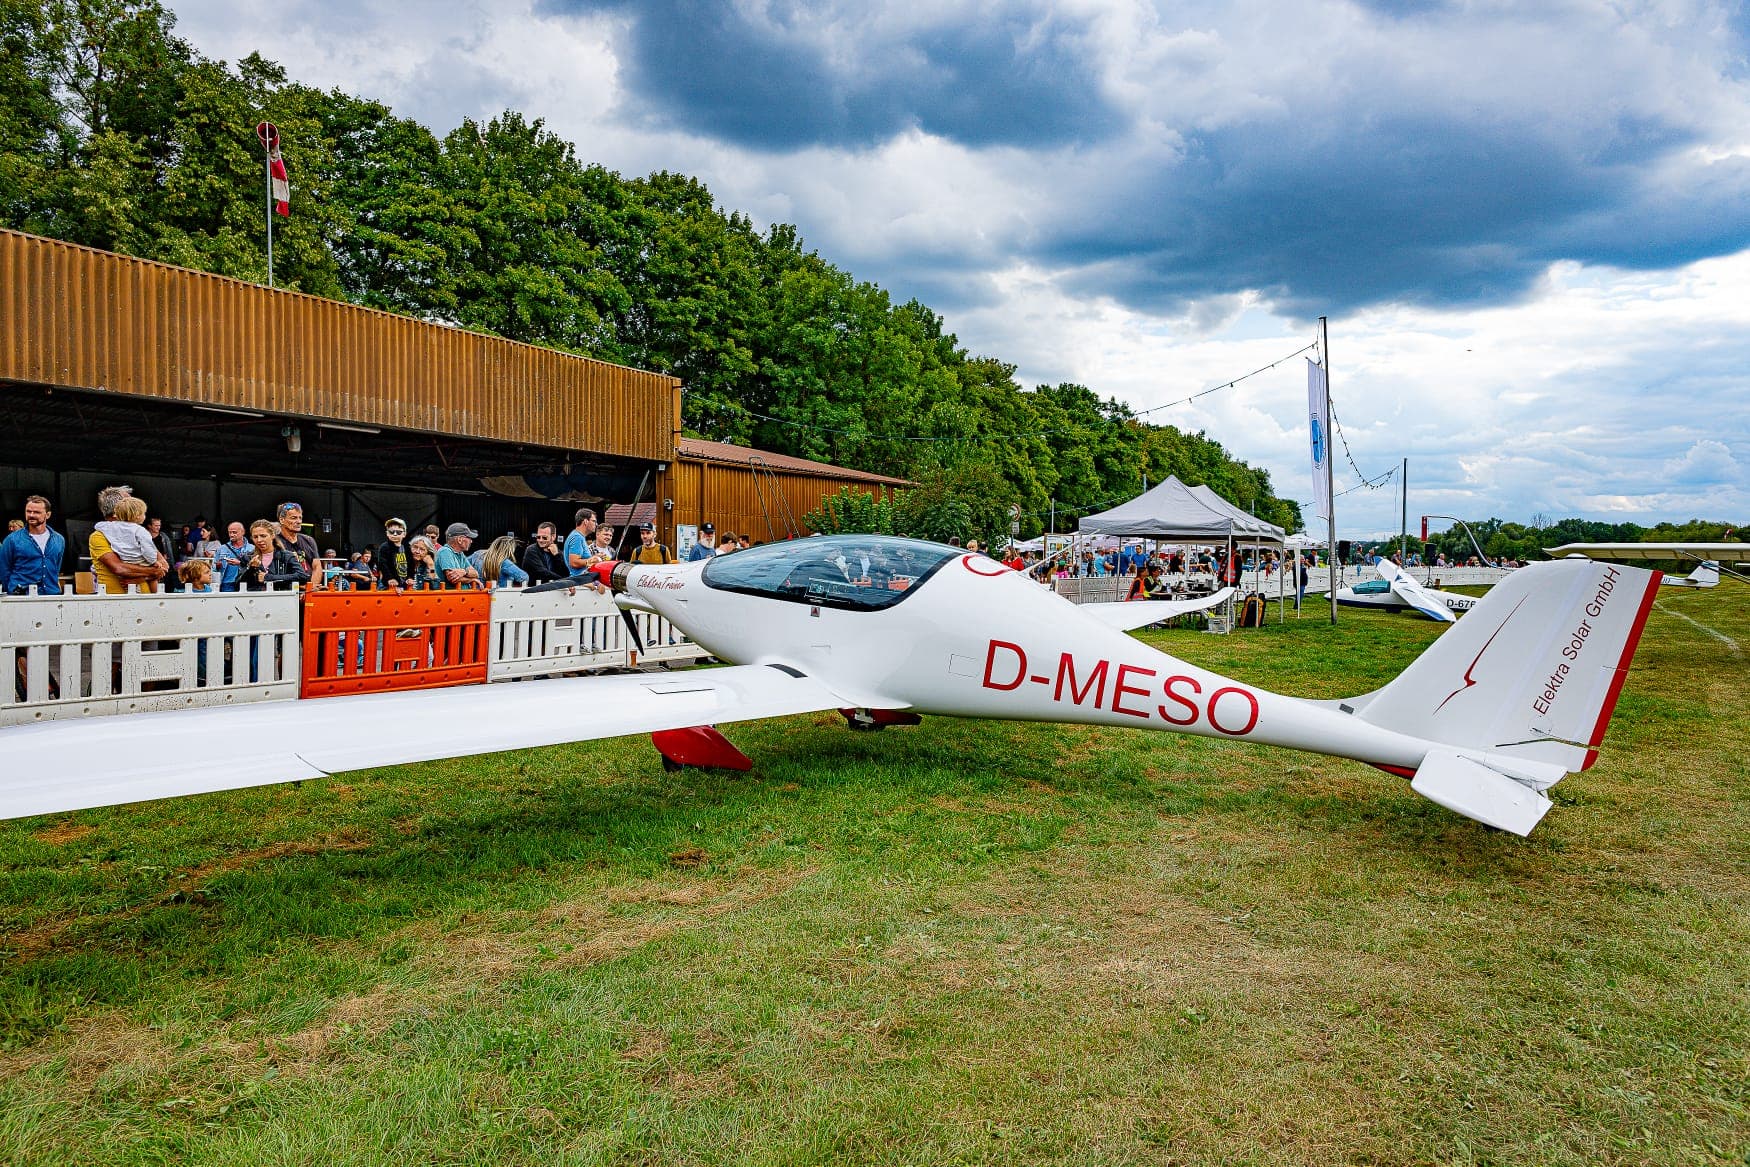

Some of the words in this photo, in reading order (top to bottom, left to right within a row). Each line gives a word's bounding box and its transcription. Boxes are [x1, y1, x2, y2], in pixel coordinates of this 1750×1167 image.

[982, 639, 1259, 736] D-MESO
[1533, 663, 1570, 715] Elektra
[1562, 619, 1592, 660] Solar
[1585, 566, 1621, 617] GmbH
